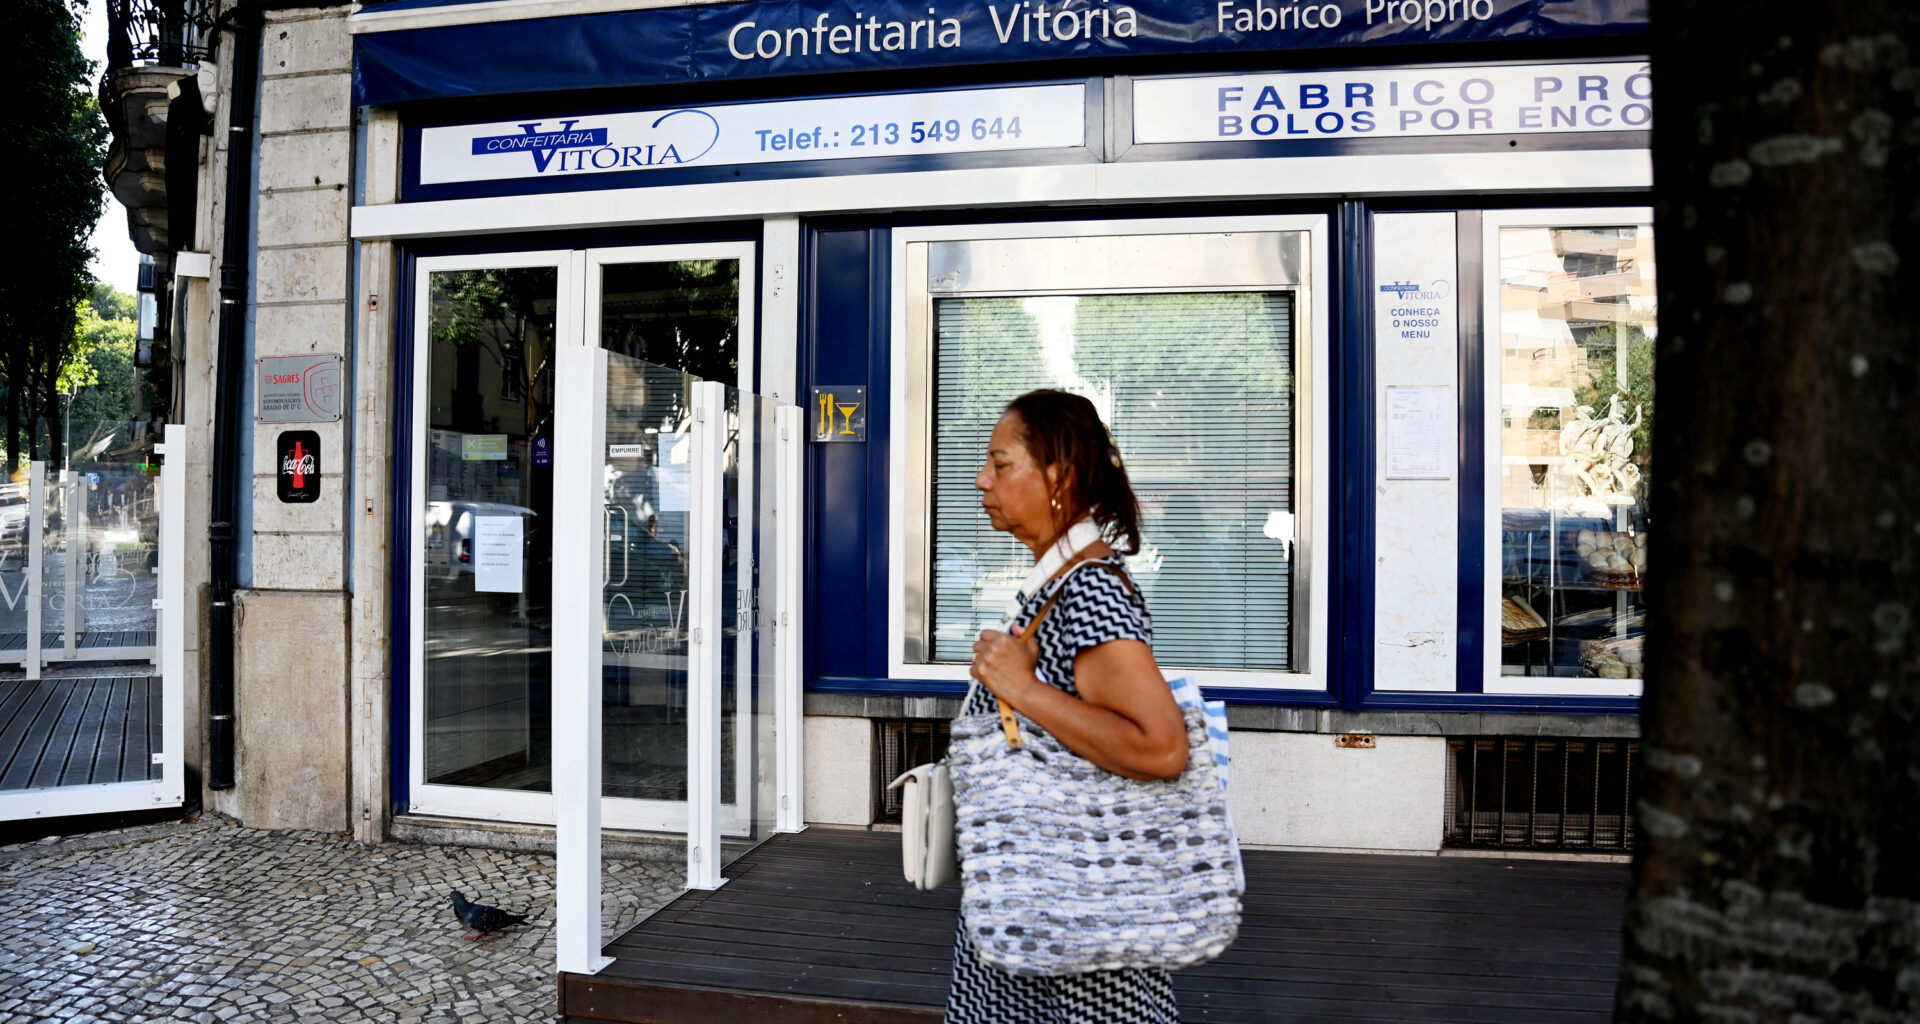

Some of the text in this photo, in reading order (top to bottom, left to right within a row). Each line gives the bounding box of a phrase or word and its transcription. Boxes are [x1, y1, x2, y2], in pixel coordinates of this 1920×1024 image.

[728, 0, 1138, 60] Confeitaria Vitória
[1217, 0, 1342, 33] Fabrico
[1218, 77, 1495, 112] FABRICO
[755, 115, 1022, 151] Telef.: 213 549 644
[1218, 110, 1376, 136] BOLOS
[1400, 108, 1493, 131] POR
[486, 132, 595, 151] CONFEITARIA
[518, 119, 686, 173] VITÓRIA
[1391, 308, 1440, 318] CONHEÇA
[1392, 318, 1439, 328] O NOSSO
[1401, 330, 1430, 339] MENU
[273, 373, 300, 385] SAGRES
